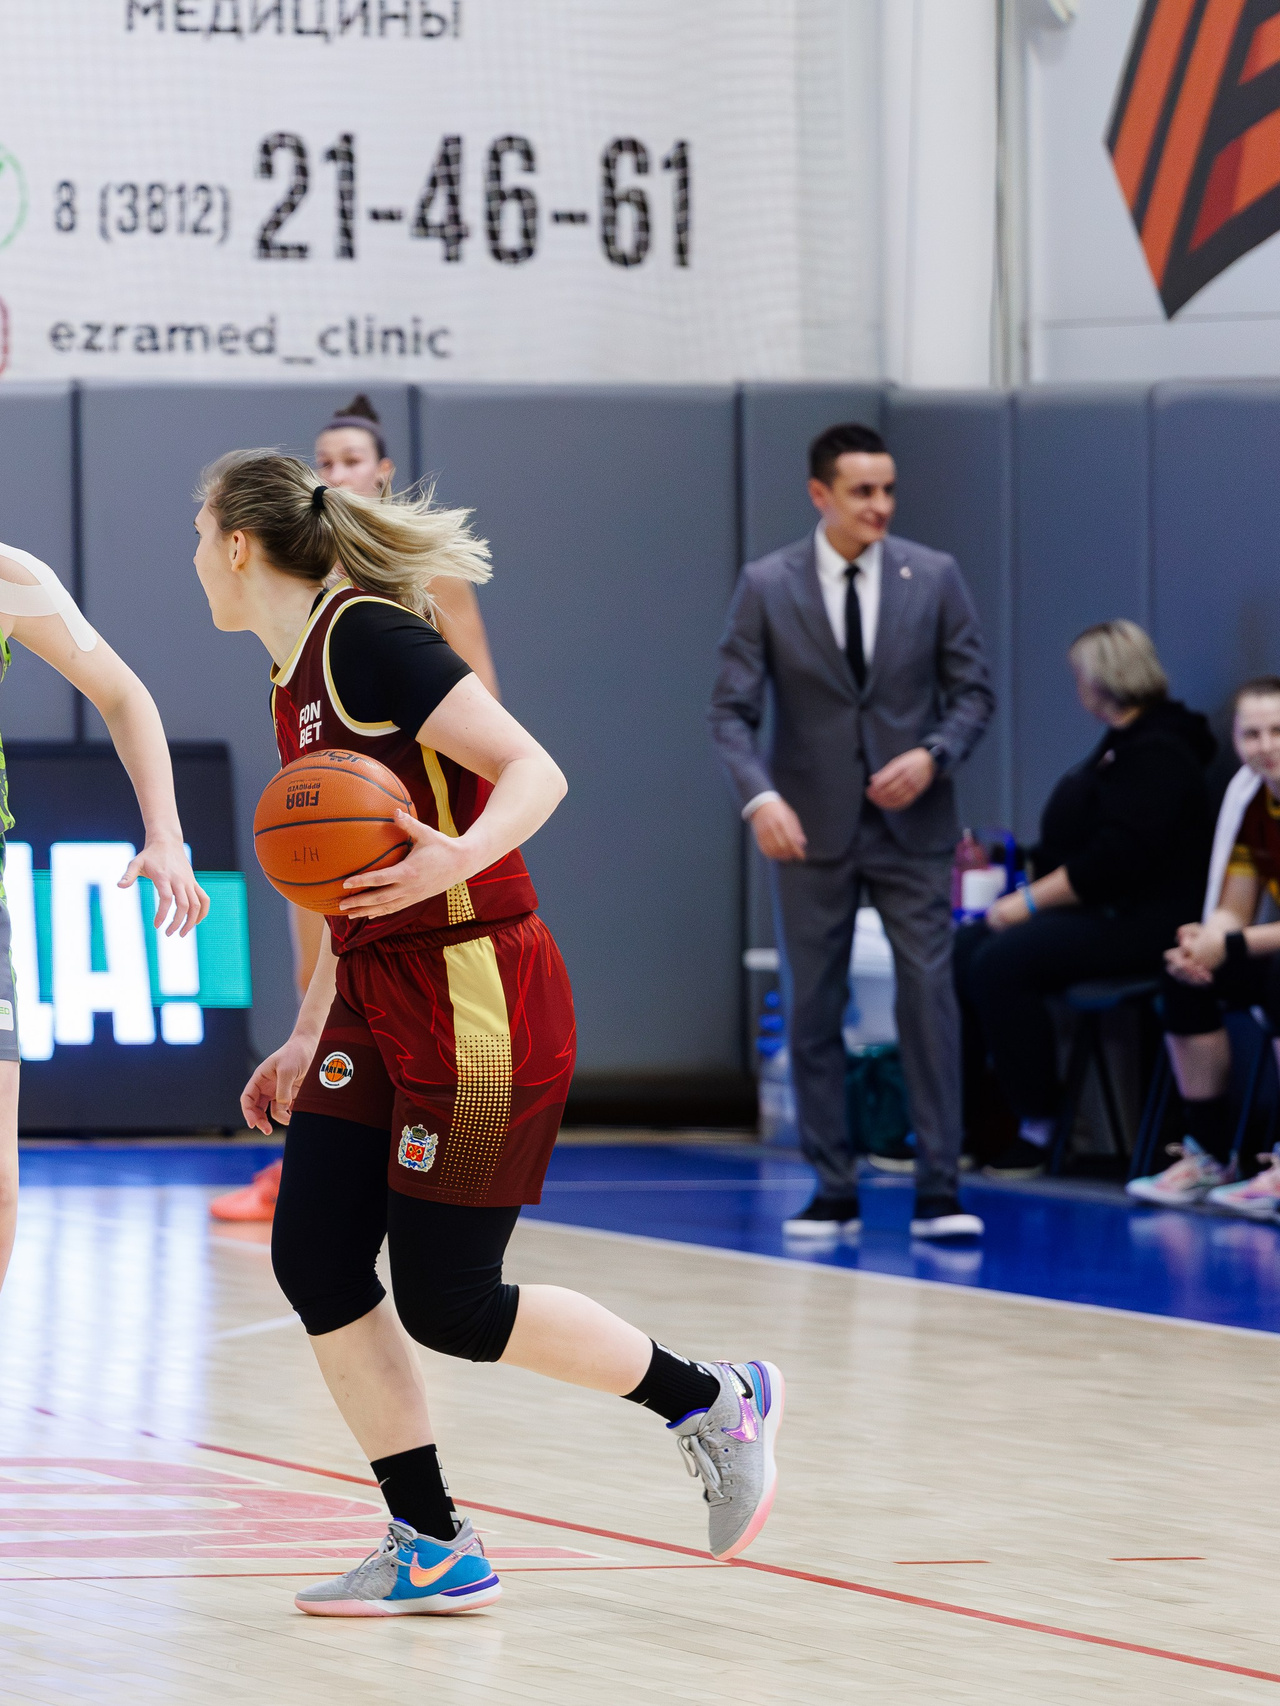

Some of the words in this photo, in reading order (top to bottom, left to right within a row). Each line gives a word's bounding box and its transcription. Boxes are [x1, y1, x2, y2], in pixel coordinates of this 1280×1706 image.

[124, 0, 461, 44] МЕДИЦИНЫ
[54, 181, 77, 234] 8
[100, 181, 232, 244] (3812)
[256, 131, 694, 270] 21-46-61
[50, 315, 453, 366] ezramed_clinic
[298, 699, 322, 729] FON
[298, 720, 323, 750] BET
[285, 790, 321, 811] FIBA
